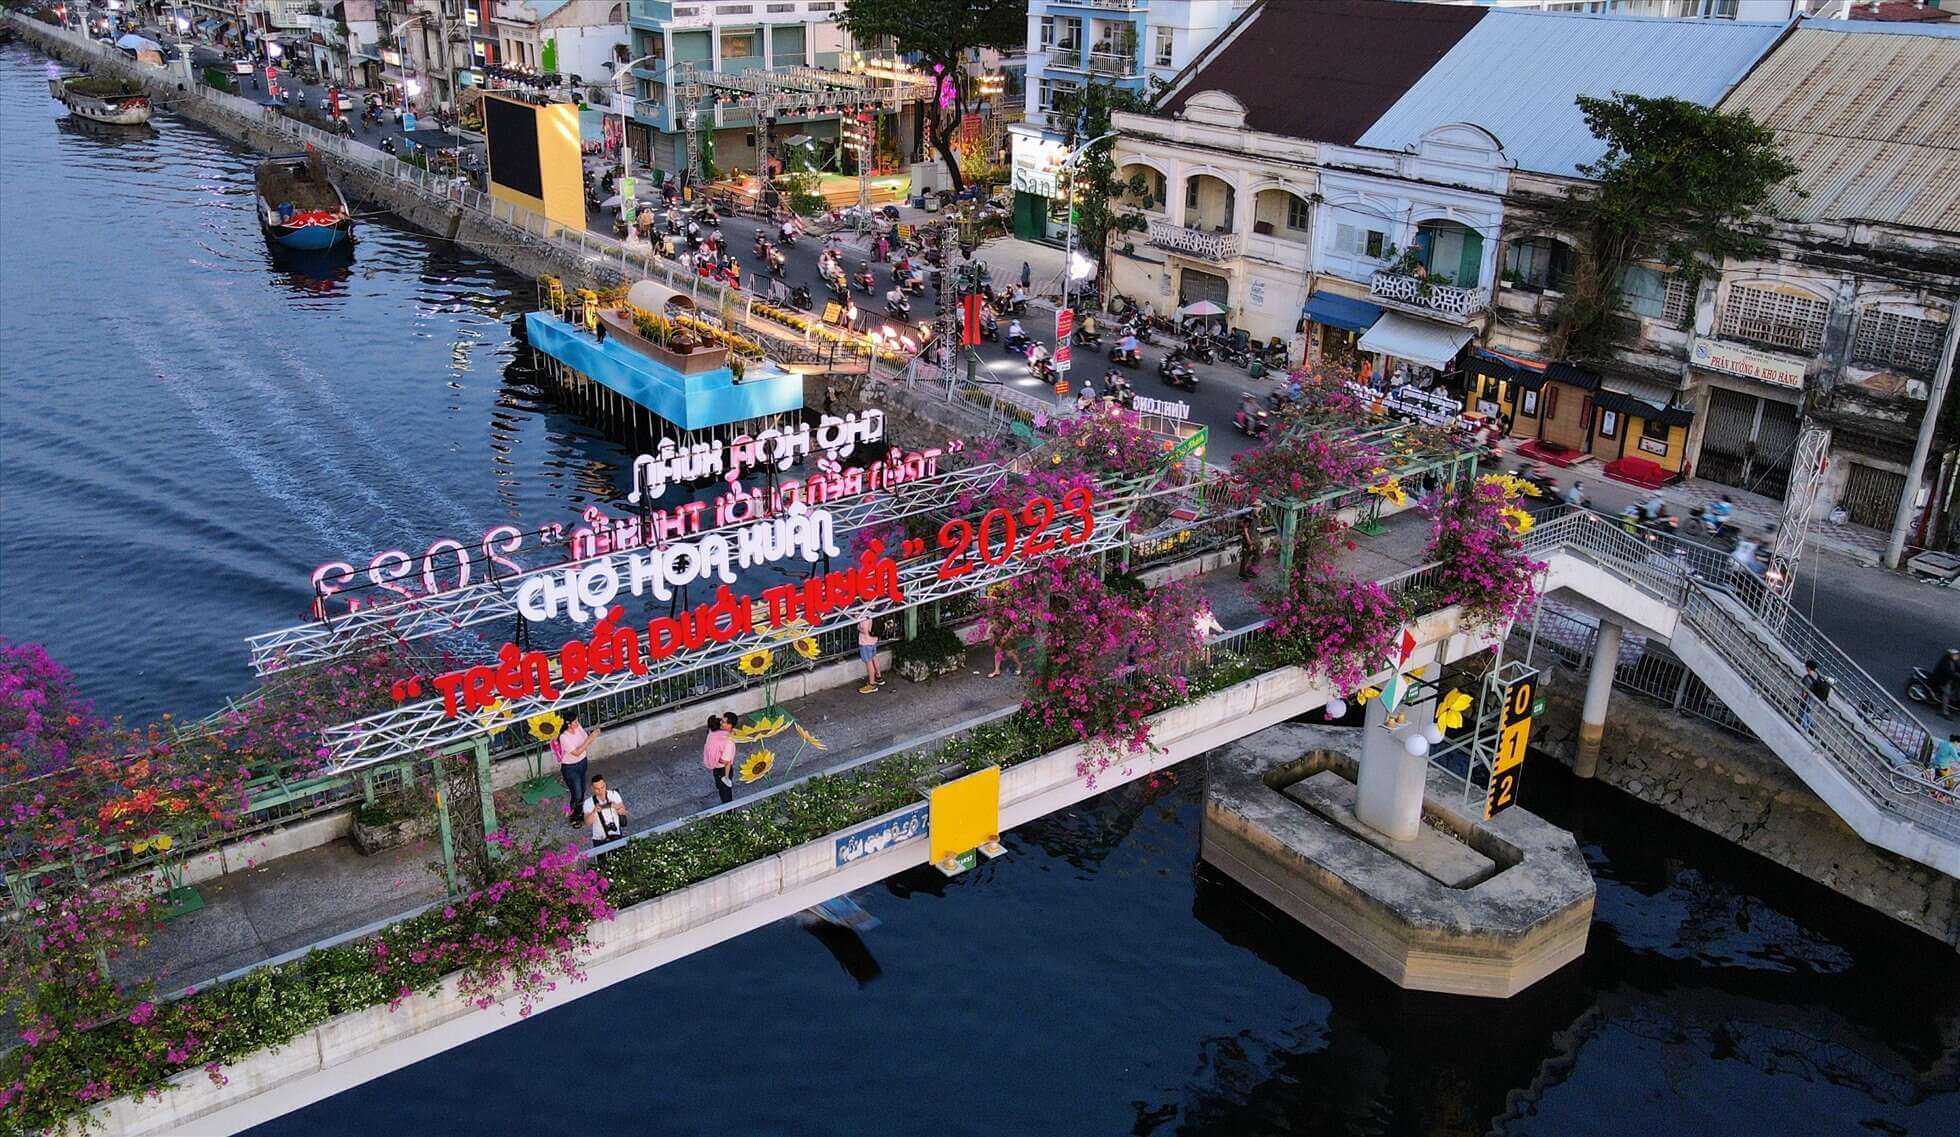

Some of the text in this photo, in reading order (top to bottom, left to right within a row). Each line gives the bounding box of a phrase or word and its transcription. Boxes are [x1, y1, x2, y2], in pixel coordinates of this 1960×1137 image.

[937, 487, 1096, 580] 2023
[517, 556, 619, 623] CHỢ
[630, 533, 737, 602] HOA
[1514, 684, 1531, 715] 0
[1509, 731, 1520, 759] 1
[1497, 775, 1513, 806] 2
